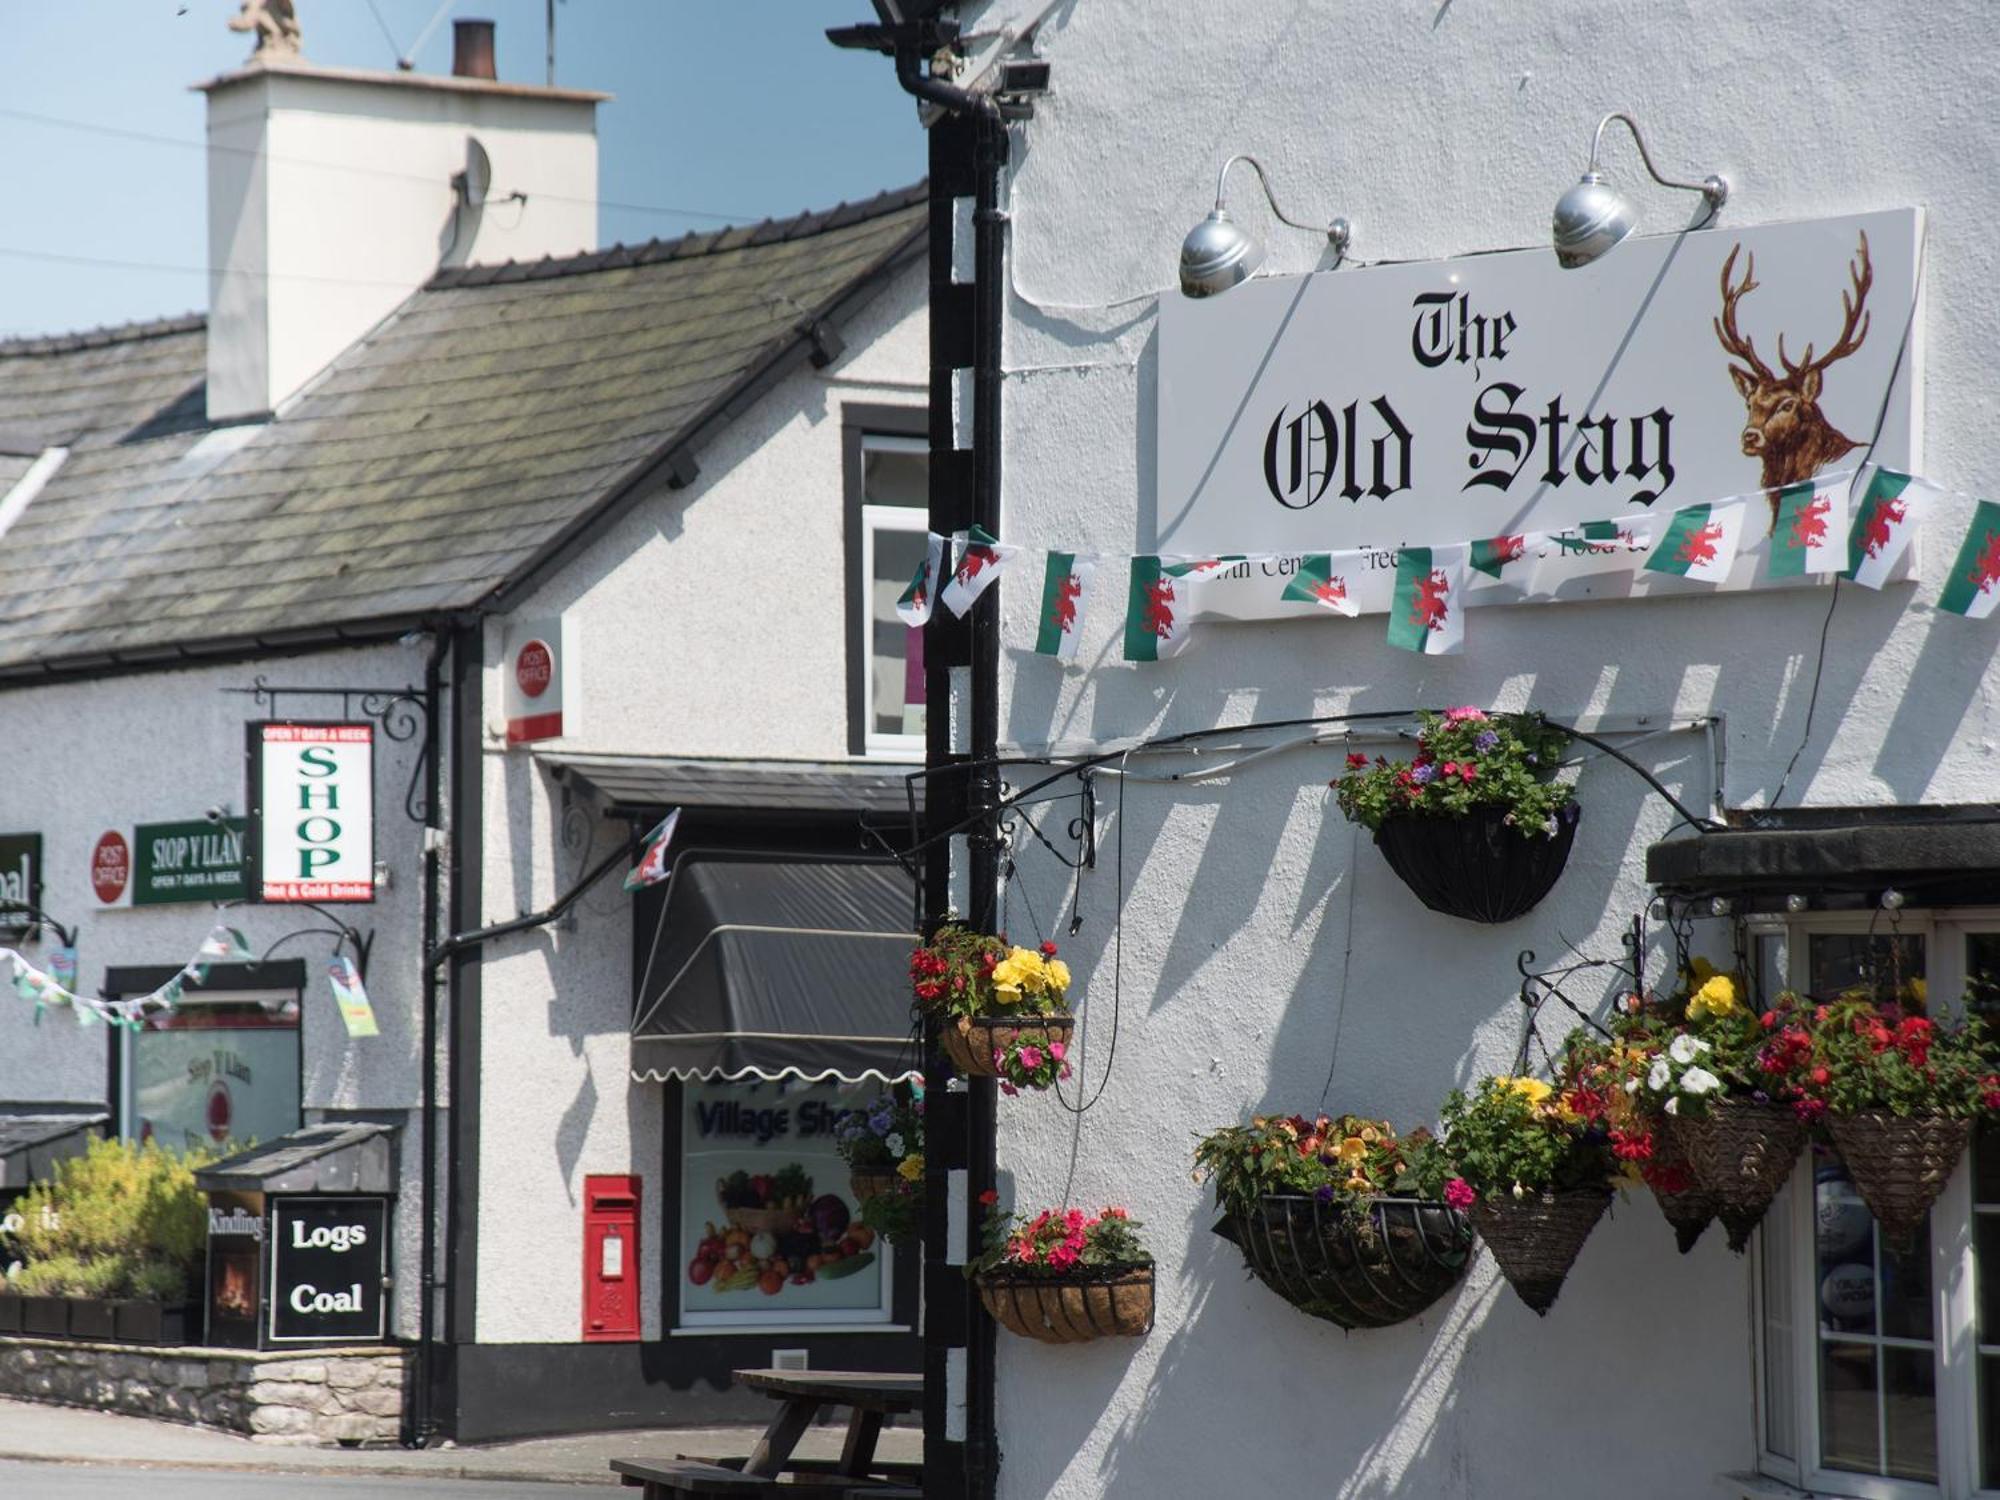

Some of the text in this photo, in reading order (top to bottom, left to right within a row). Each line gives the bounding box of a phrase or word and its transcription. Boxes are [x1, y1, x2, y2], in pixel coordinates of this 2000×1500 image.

[1411, 290, 1519, 383] The
[1263, 381, 1675, 510] Old Stag
[522, 650, 547, 667] POST
[519, 666, 550, 684] OFFICE
[263, 727, 292, 741] OPEN
[302, 727, 328, 741] DAYS
[338, 727, 371, 741] WEEK
[296, 746, 342, 878] SHOP
[99, 845, 124, 865] POST
[152, 832, 244, 869] SIOP Y LLAN
[95, 865, 126, 886] OFFICE
[151, 875, 175, 889] OPEN
[183, 873, 205, 887] DAYS
[214, 871, 241, 885] WEEK
[695, 1101, 790, 1145] Village
[209, 1207, 265, 1242] Kindling
[291, 1220, 368, 1252] Logs
[290, 1283, 363, 1314] Coal
